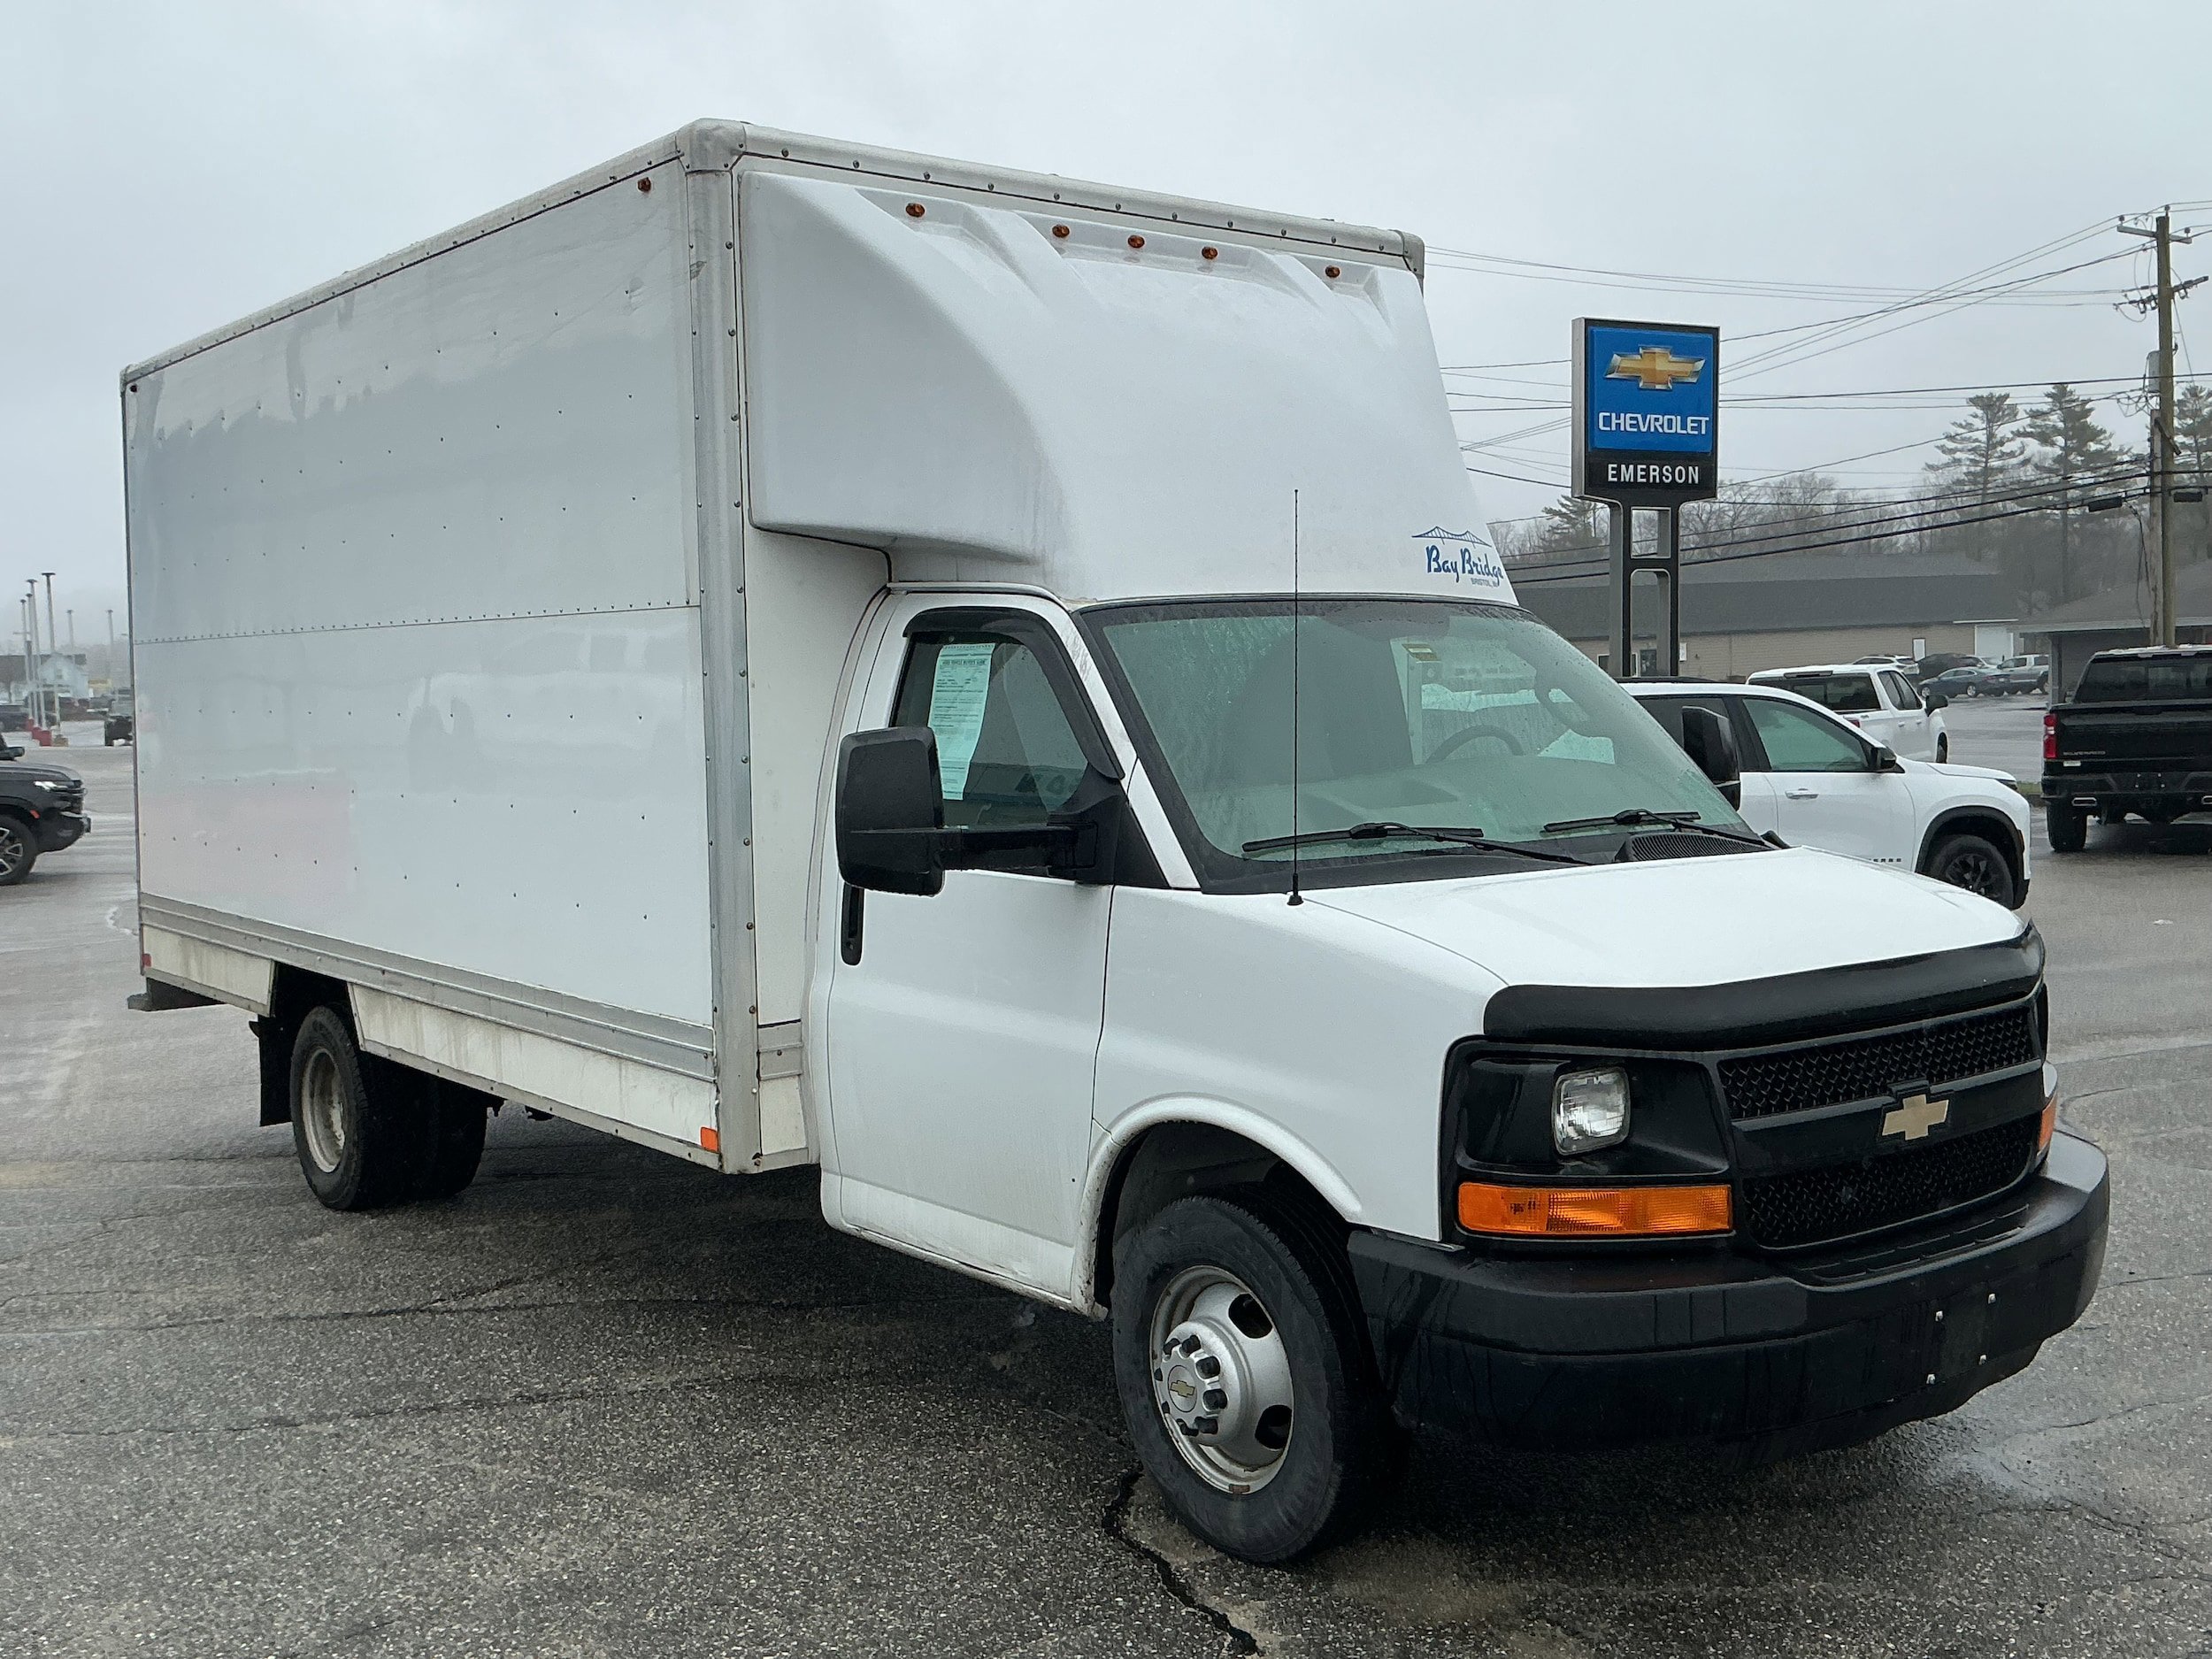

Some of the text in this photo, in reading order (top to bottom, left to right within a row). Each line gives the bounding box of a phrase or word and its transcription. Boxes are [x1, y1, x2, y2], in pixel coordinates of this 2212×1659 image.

[1598, 411, 1709, 435] CHEVROLET
[1607, 463, 1700, 485] EMERSON
[1425, 544, 1504, 588] Bay Bridge
